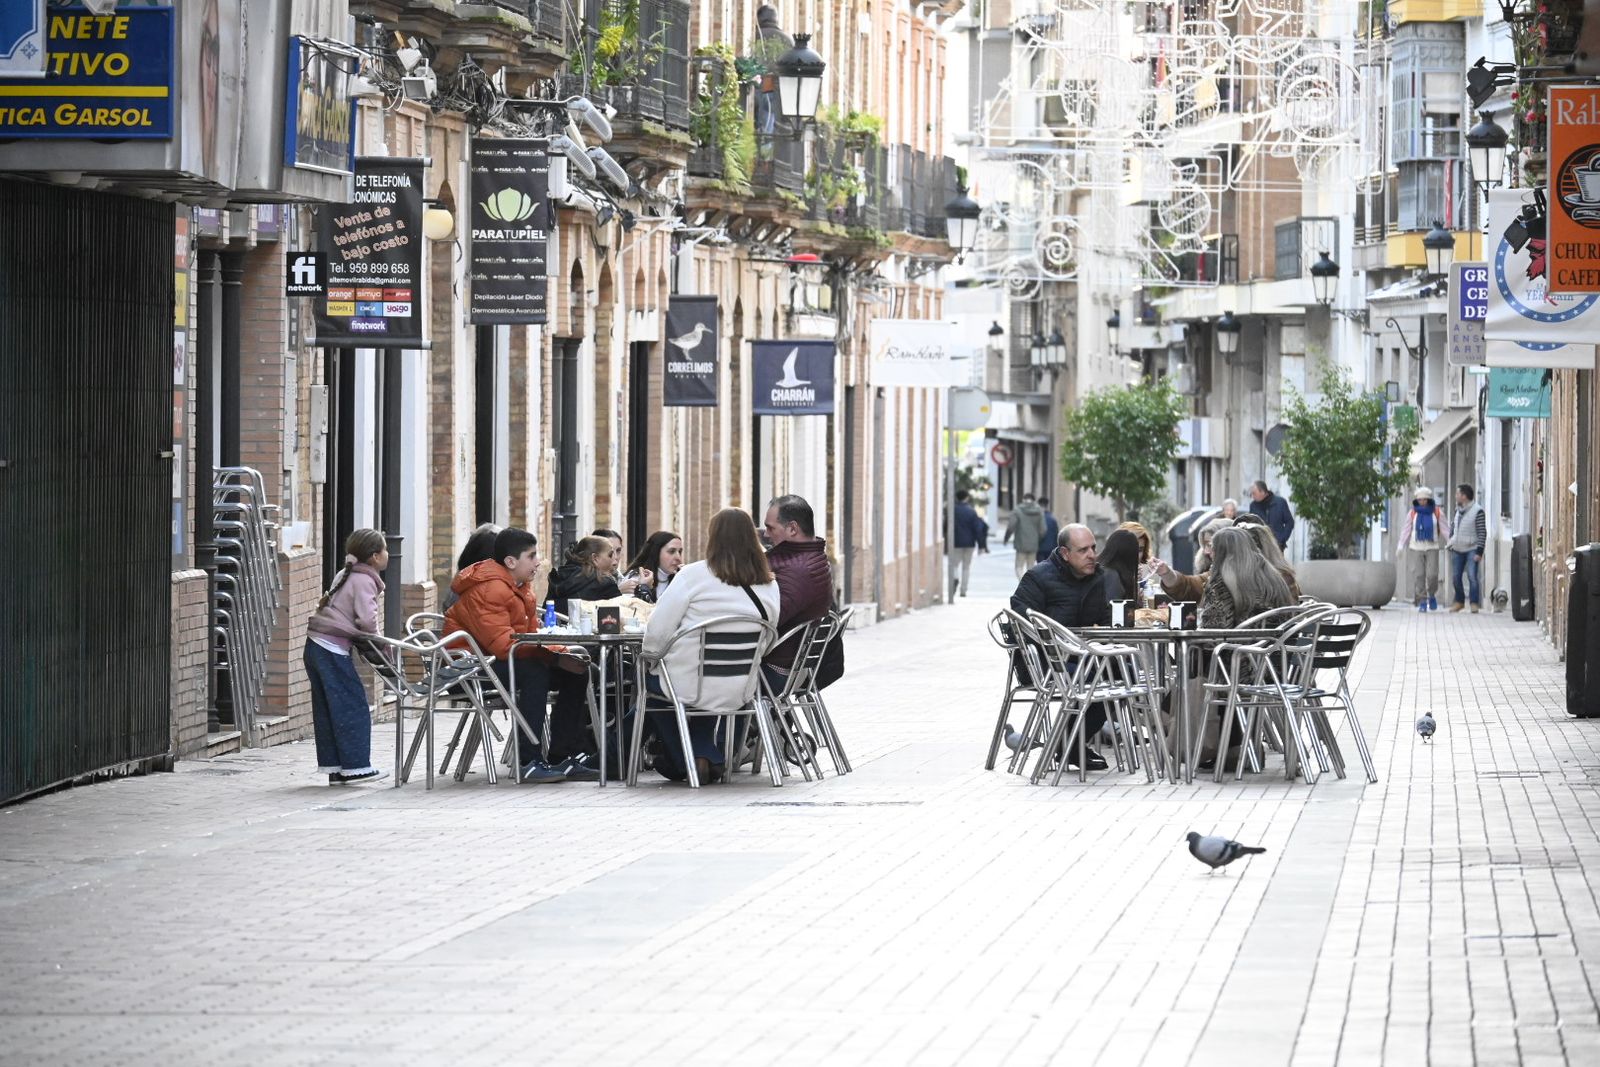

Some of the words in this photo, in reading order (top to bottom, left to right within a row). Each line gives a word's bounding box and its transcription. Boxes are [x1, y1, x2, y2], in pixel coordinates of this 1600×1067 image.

[50, 16, 130, 39] NETE
[54, 103, 153, 127] GARSOL
[356, 175, 367, 187] DE
[368, 173, 411, 188] TELEFONÍA
[334, 211, 373, 229] Venta
[373, 206, 391, 218] de
[395, 219, 406, 229] a
[472, 227, 547, 239] PARATUPIEL
[341, 244, 371, 260] bajo
[373, 234, 409, 252] costo
[1555, 242, 1600, 260] CHUR
[291, 256, 316, 285] fi
[330, 263, 347, 274] Tel.
[349, 263, 368, 274] 959
[370, 263, 389, 274] 899
[391, 262, 410, 274] 658
[287, 284, 322, 292] network
[1467, 288, 1488, 300] CE
[328, 291, 353, 300] orange
[475, 294, 506, 302] Depilación
[387, 304, 409, 313] yoigo
[1464, 305, 1486, 318] DE
[351, 320, 386, 331] finetwork
[667, 361, 714, 374] CORRELIMOS
[771, 386, 816, 402] CHARRÁN
